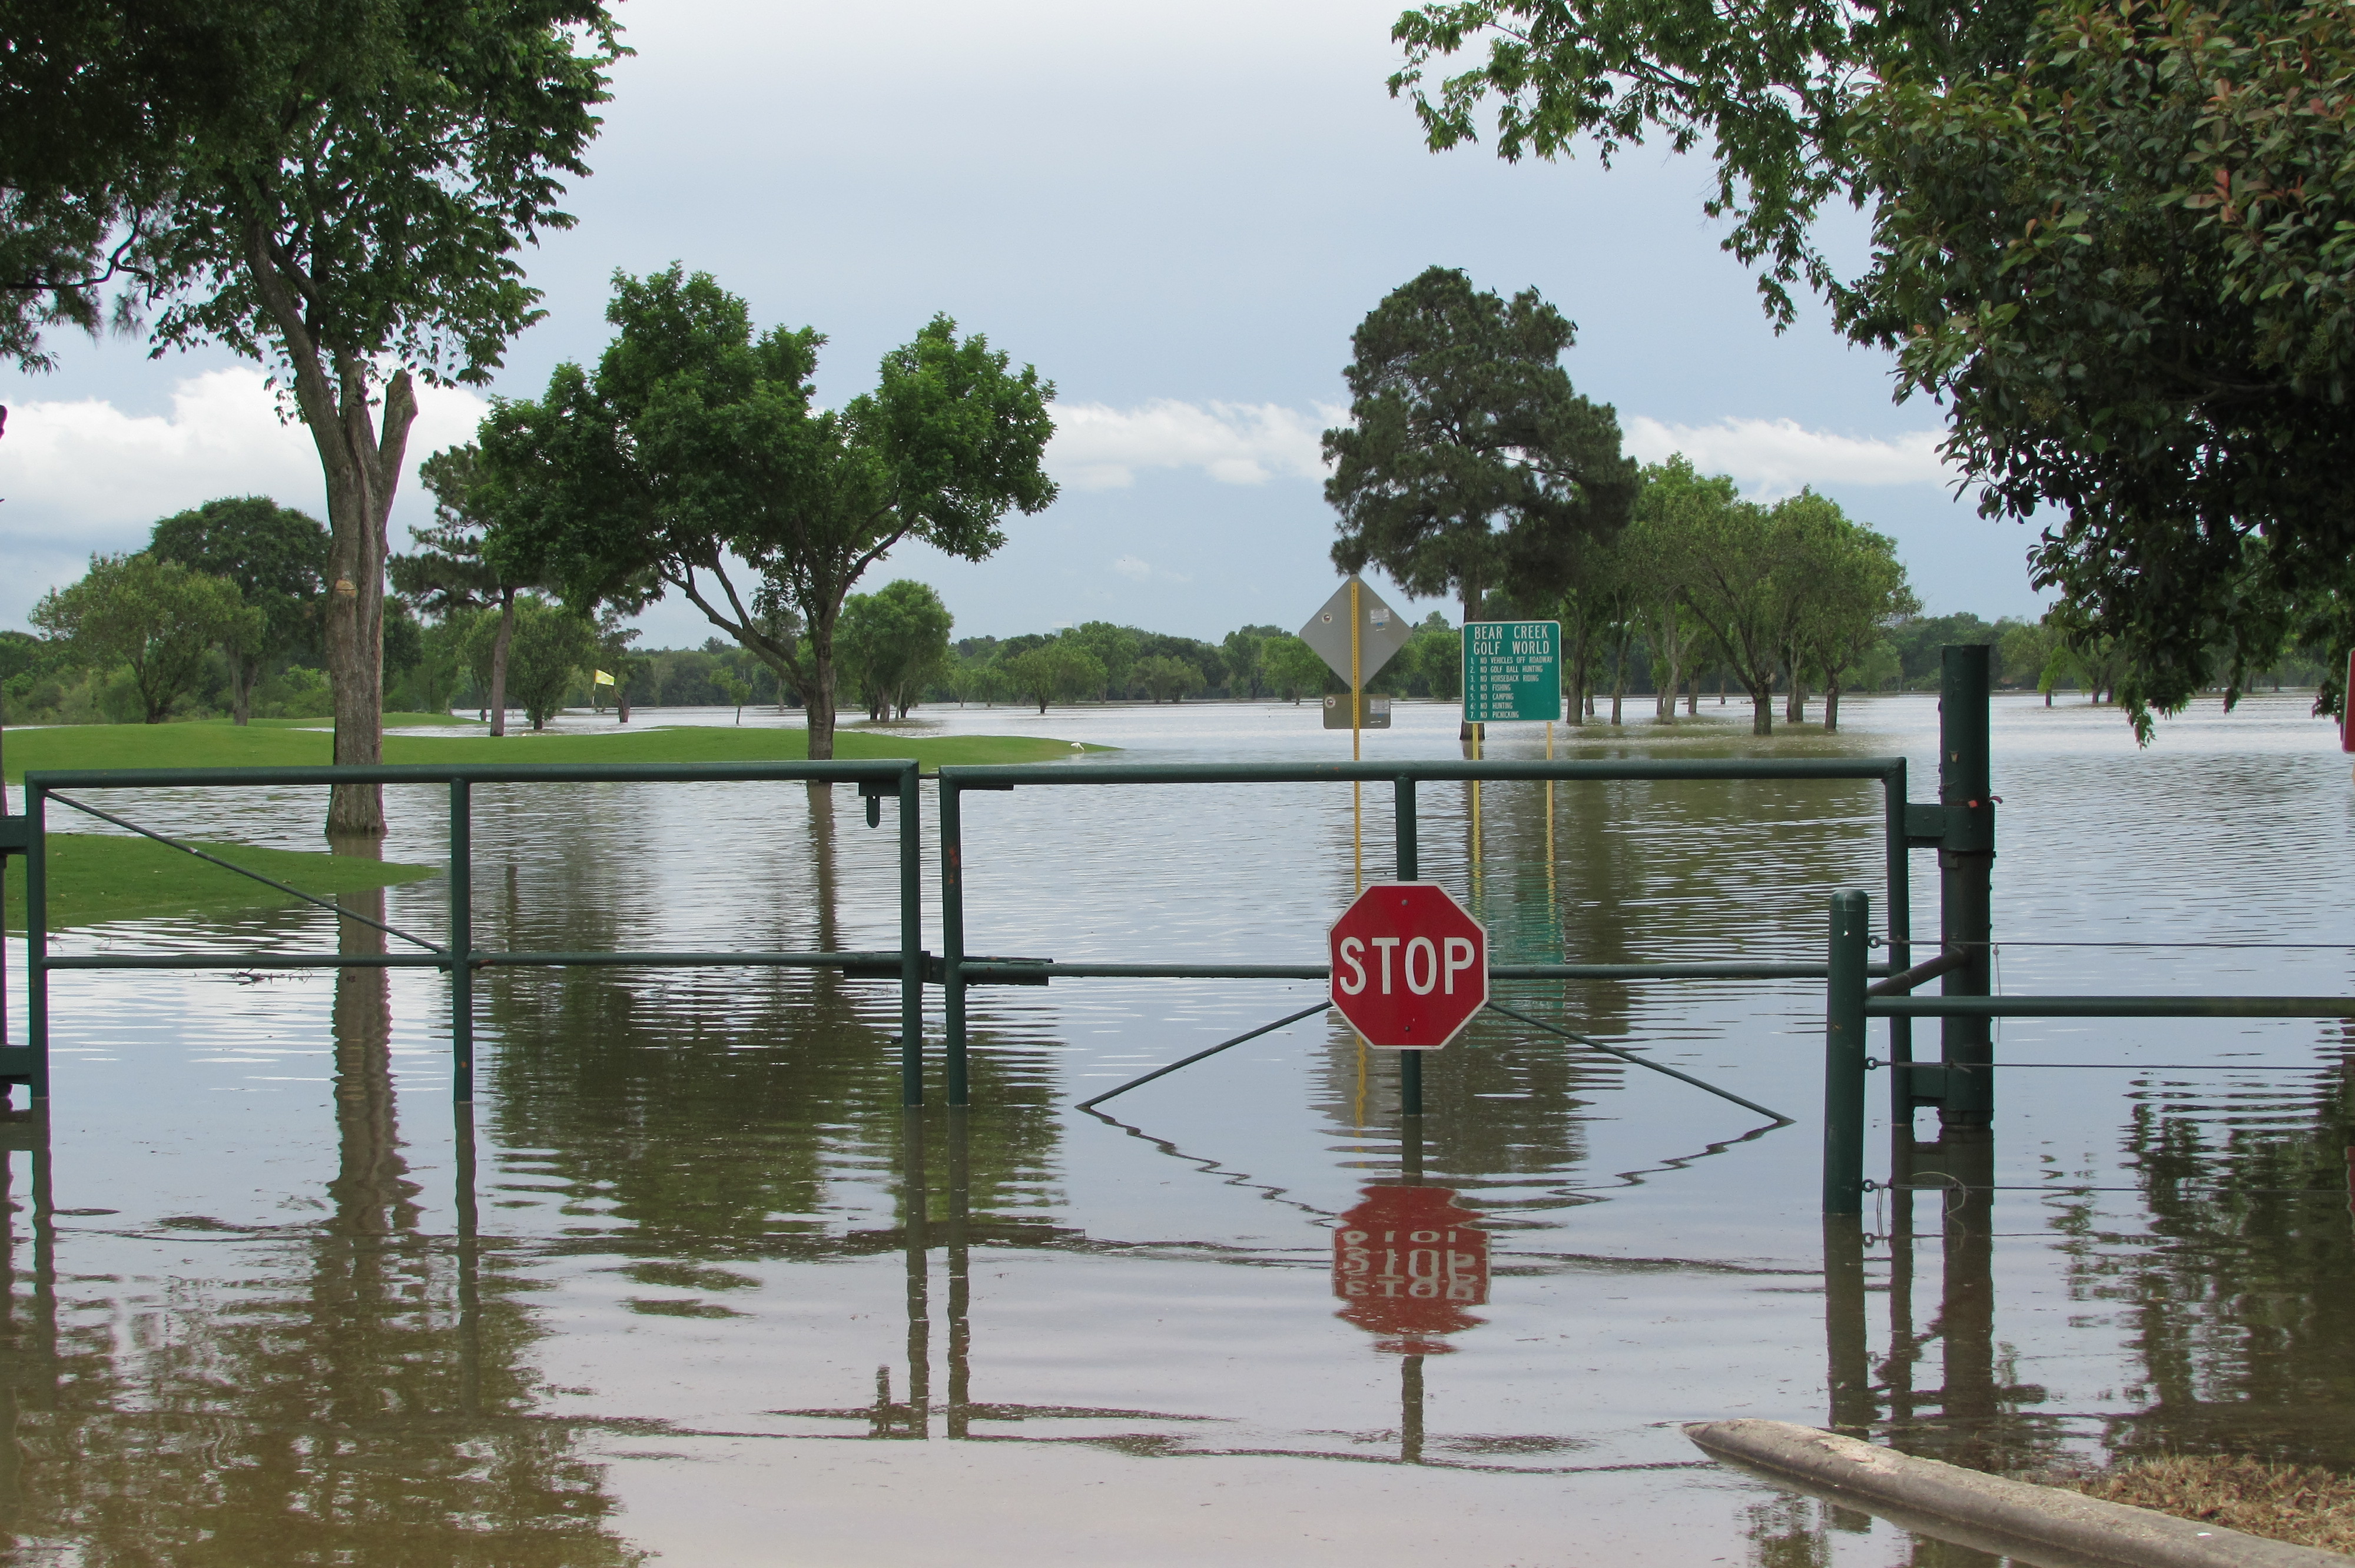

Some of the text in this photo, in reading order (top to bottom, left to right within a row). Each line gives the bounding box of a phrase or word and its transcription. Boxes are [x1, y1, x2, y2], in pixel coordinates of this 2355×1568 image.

[1474, 625, 1548, 640] BEAR CREEK
[1474, 640, 1550, 655] GOLF WORLD
[1339, 936, 1475, 995] STOP
